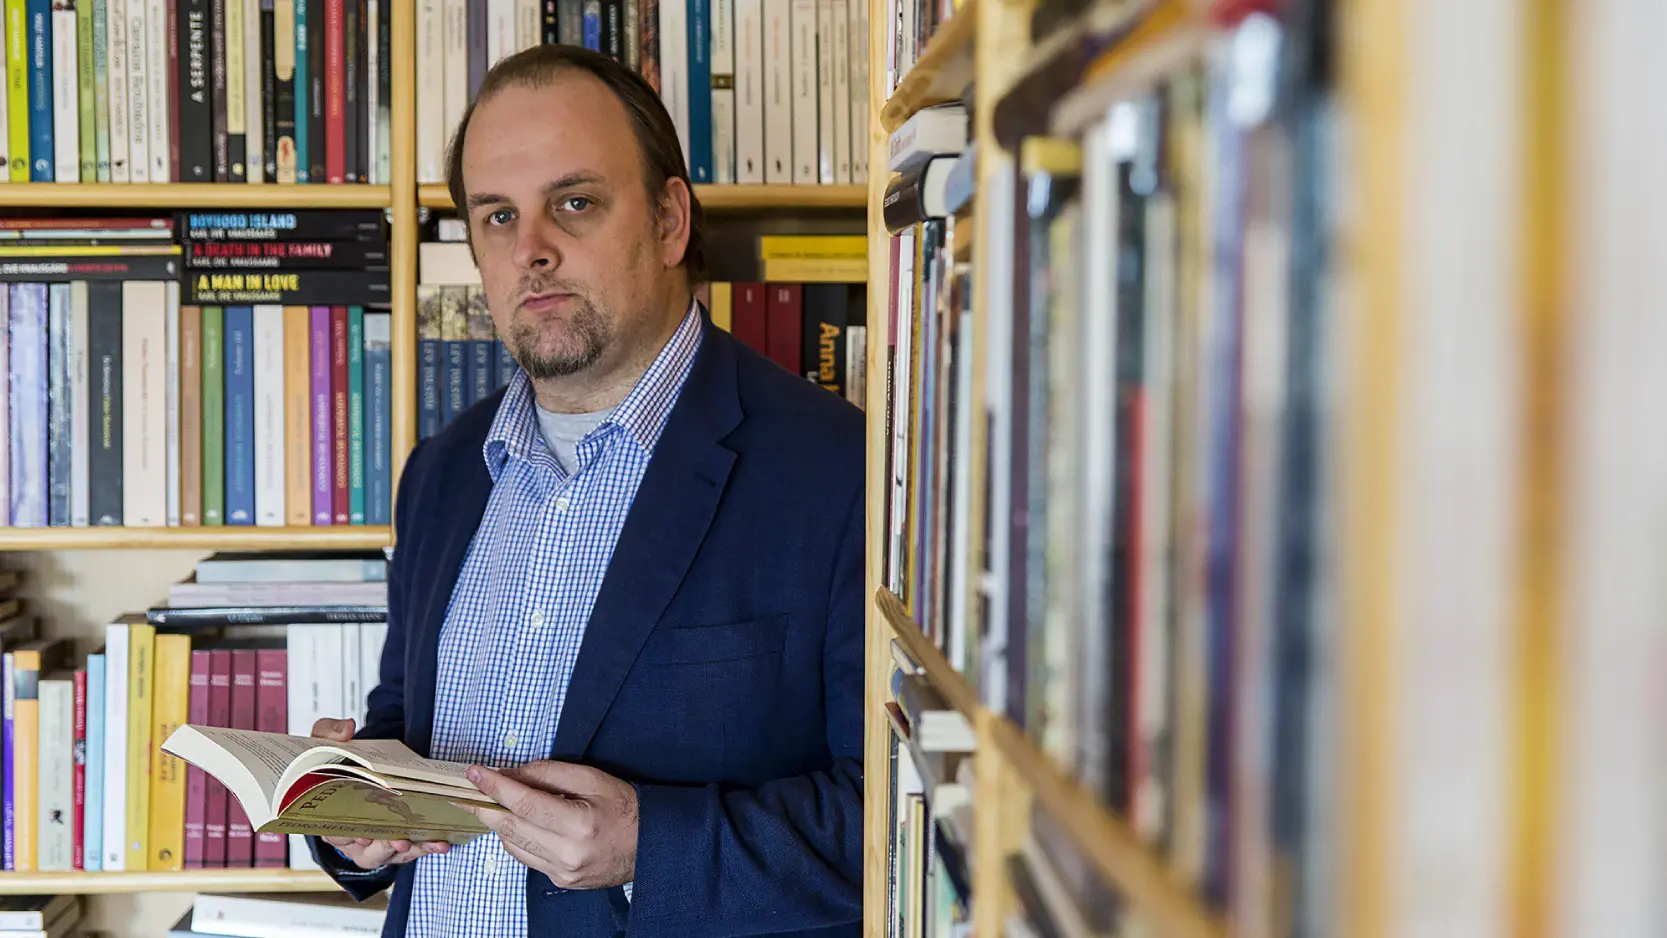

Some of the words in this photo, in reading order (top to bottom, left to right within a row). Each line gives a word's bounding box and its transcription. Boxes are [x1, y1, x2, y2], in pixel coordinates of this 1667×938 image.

[189, 11, 205, 88] SERPENTE
[191, 90, 205, 103] A
[190, 214, 246, 229] BOYHOOD
[250, 214, 296, 229] ISLAND
[193, 243, 202, 257] A
[205, 243, 244, 257] DEATH
[247, 243, 260, 257] IN
[263, 243, 286, 257] THE
[288, 243, 332, 257] FAMILY
[198, 274, 209, 290] A
[211, 274, 244, 290] MAN
[246, 274, 262, 290] IN
[264, 274, 299, 290] LOVE
[820, 322, 840, 382] Anna
[278, 821, 316, 829] PEDRO
